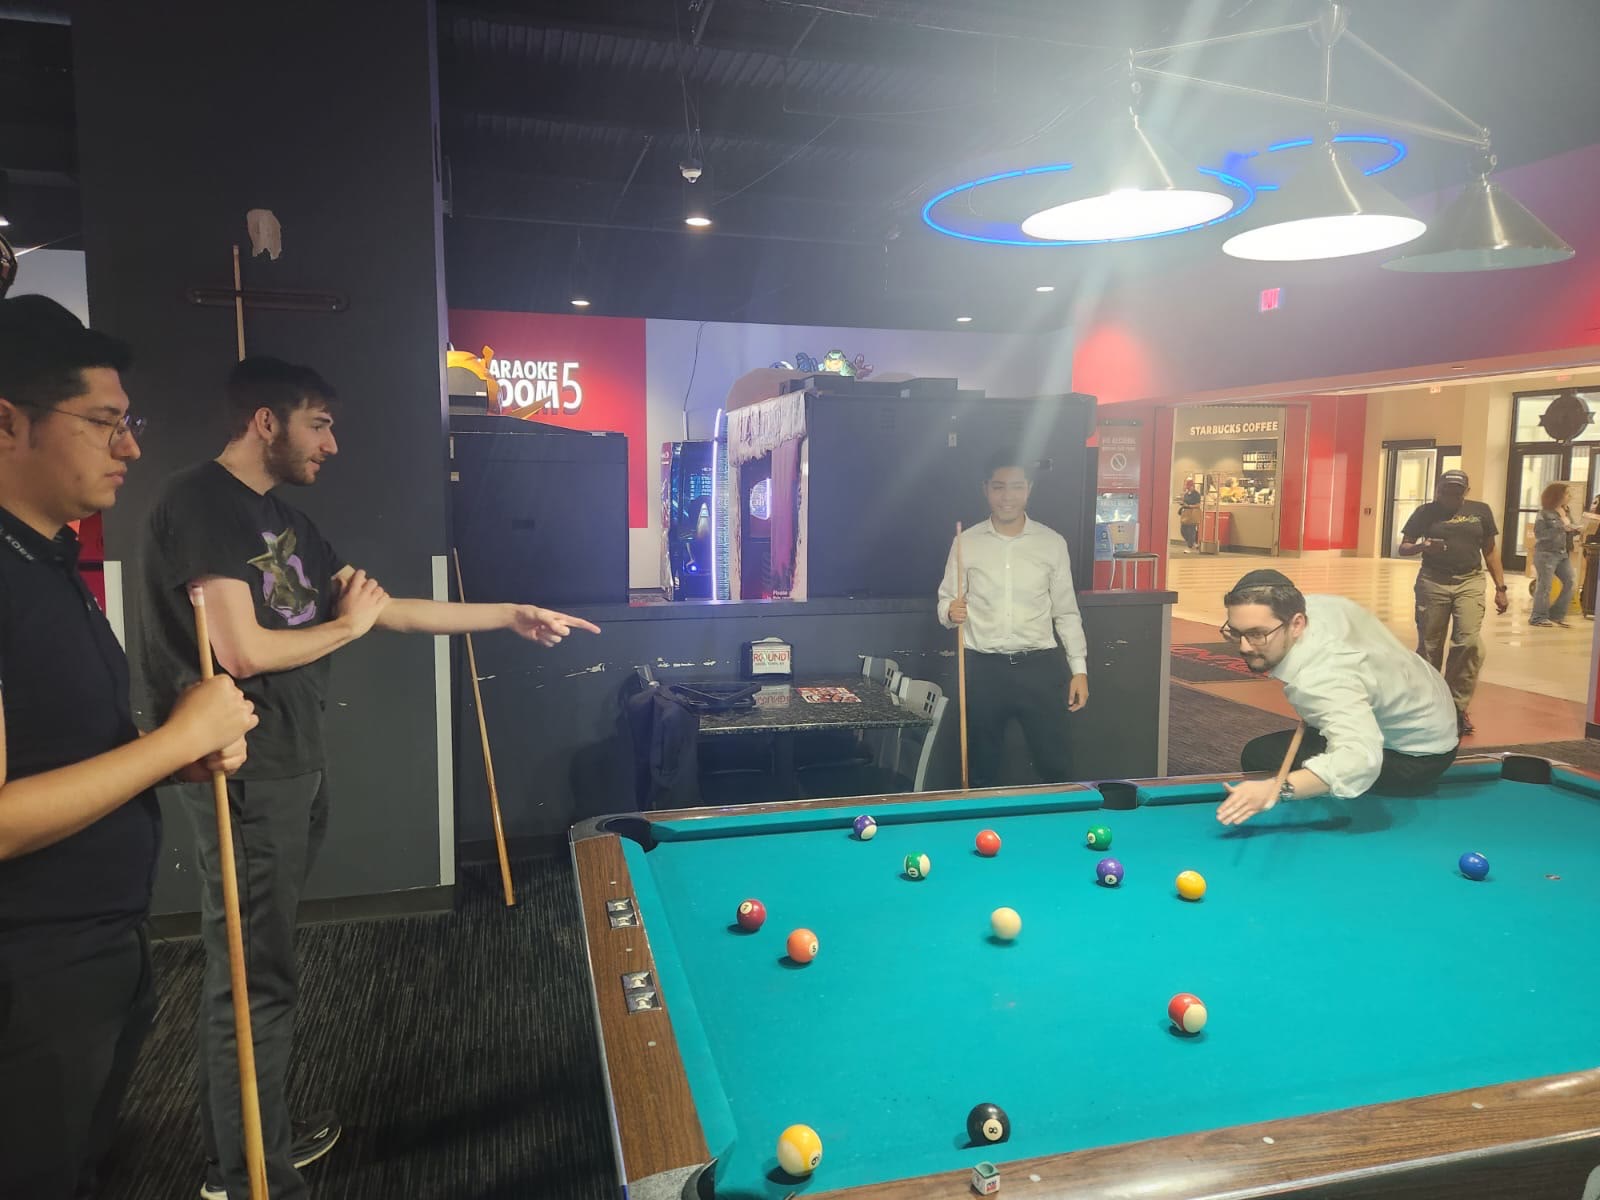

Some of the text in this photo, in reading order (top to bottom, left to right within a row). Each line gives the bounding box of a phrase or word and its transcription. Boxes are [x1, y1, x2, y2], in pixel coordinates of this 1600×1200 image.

[485, 358, 558, 380] ARAOKE
[496, 362, 583, 410] OOM 5
[1190, 420, 1280, 437] STARBUCKS COFFEE
[988, 1126, 999, 1135] 8
